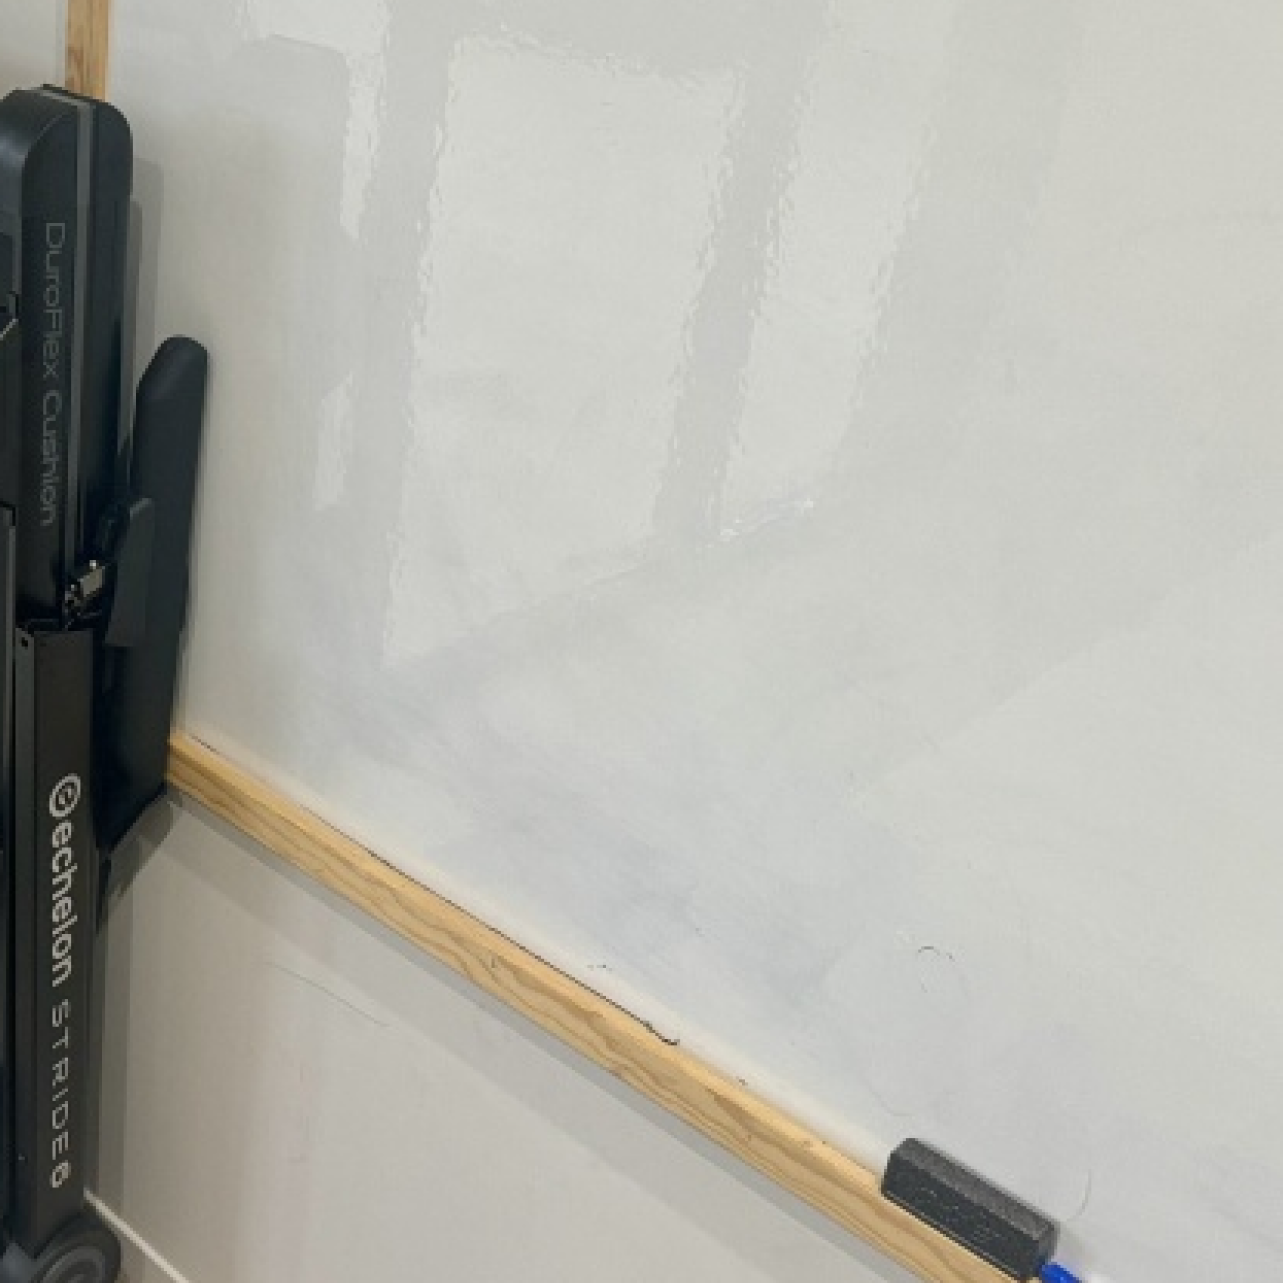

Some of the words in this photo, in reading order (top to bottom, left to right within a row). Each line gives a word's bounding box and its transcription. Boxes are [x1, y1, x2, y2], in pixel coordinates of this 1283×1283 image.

[42, 222, 66, 379] DuroFlex
[40, 389, 63, 526] Cushion
[51, 820, 78, 987] echelon
